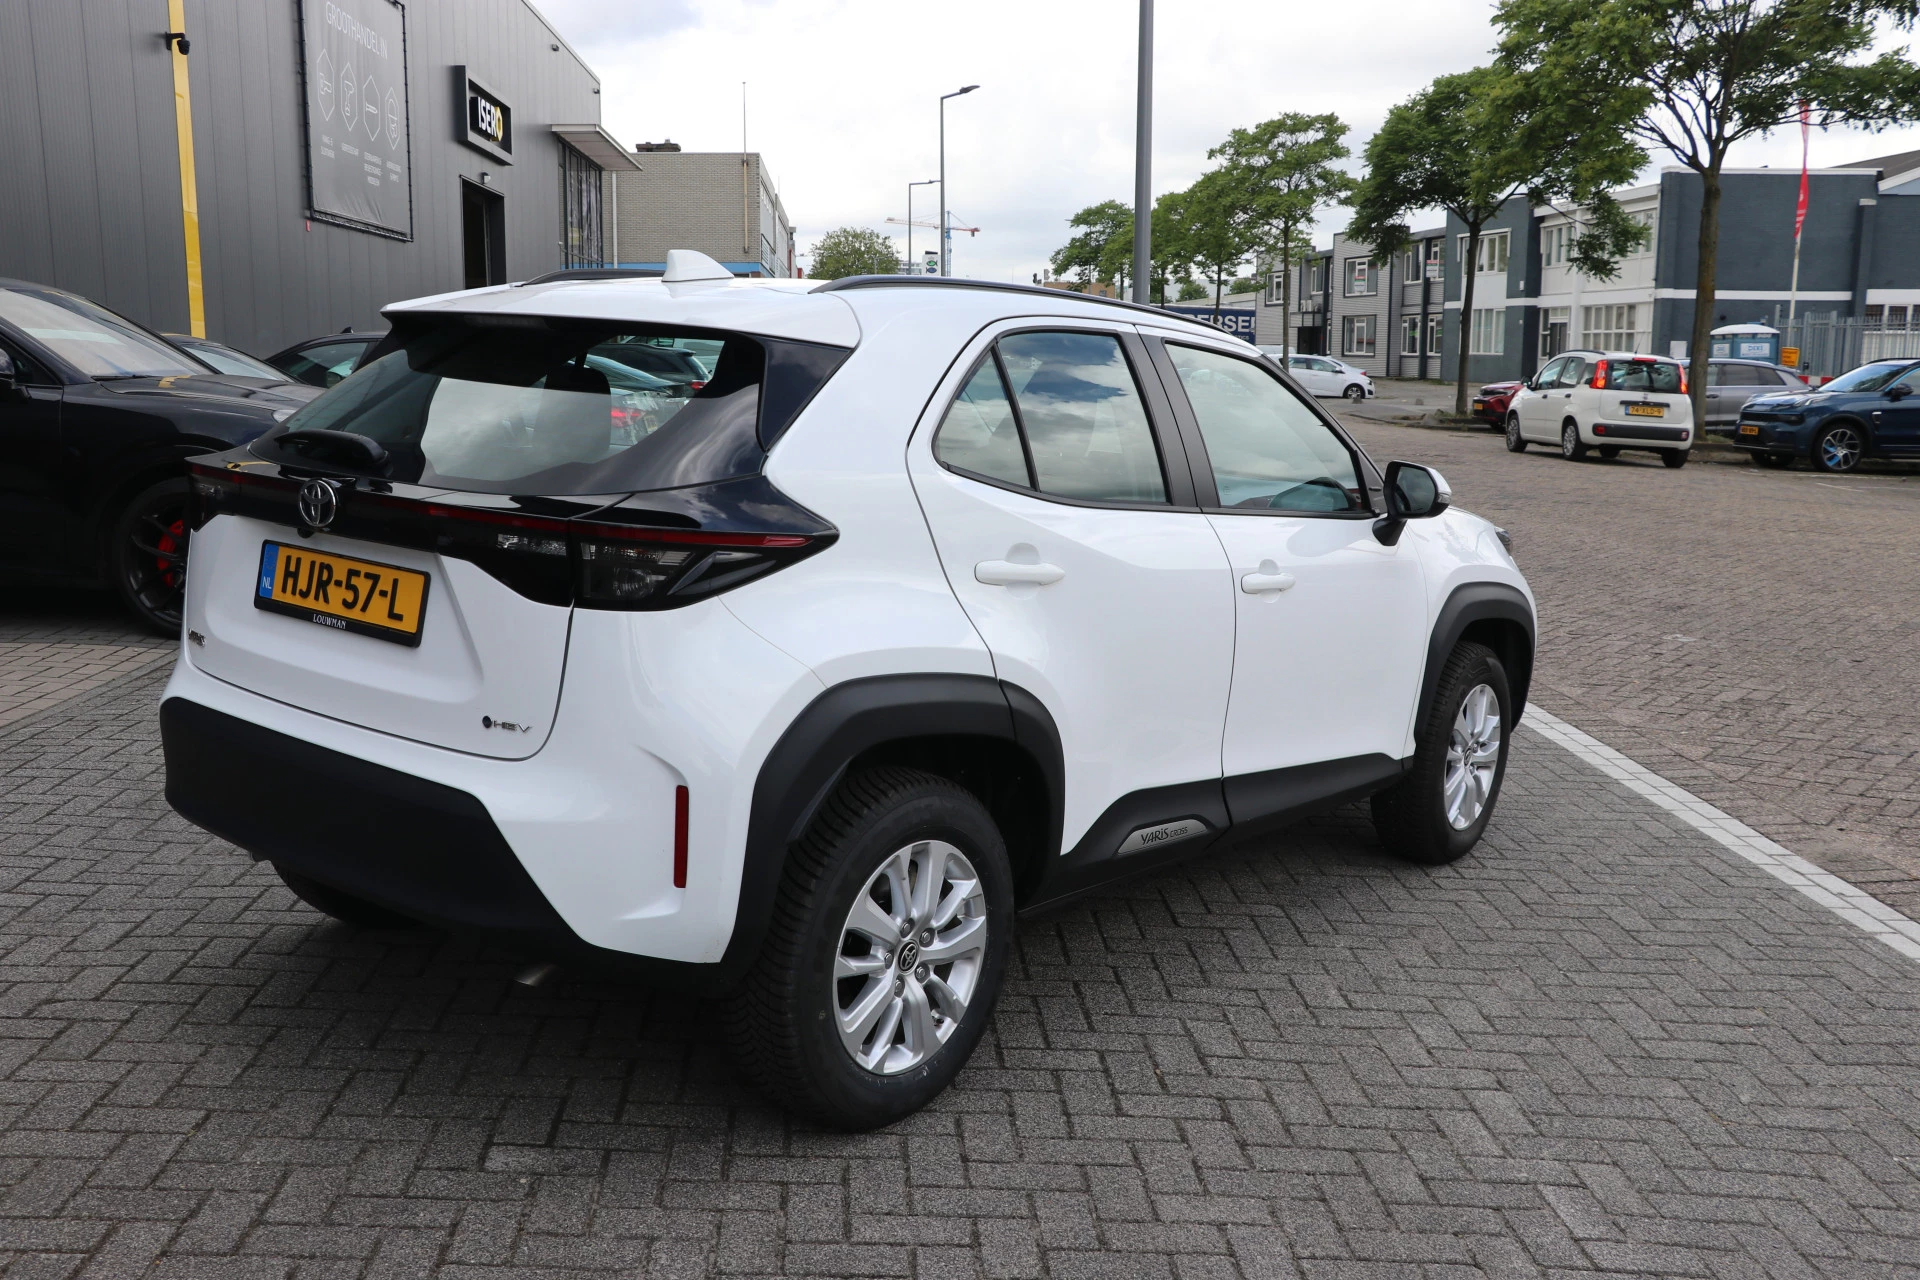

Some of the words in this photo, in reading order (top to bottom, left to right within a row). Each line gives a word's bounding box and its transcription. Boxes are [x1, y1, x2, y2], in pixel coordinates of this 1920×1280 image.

[326, 1, 380, 55] GROOTHANDEL
[380, 36, 388, 60] IN
[478, 96, 503, 141] ISERO
[262, 576, 272, 590] NL
[281, 555, 404, 622] HJR-57-L
[313, 613, 347, 630] LOUWMAN
[1170, 826, 1188, 838] CROSS
